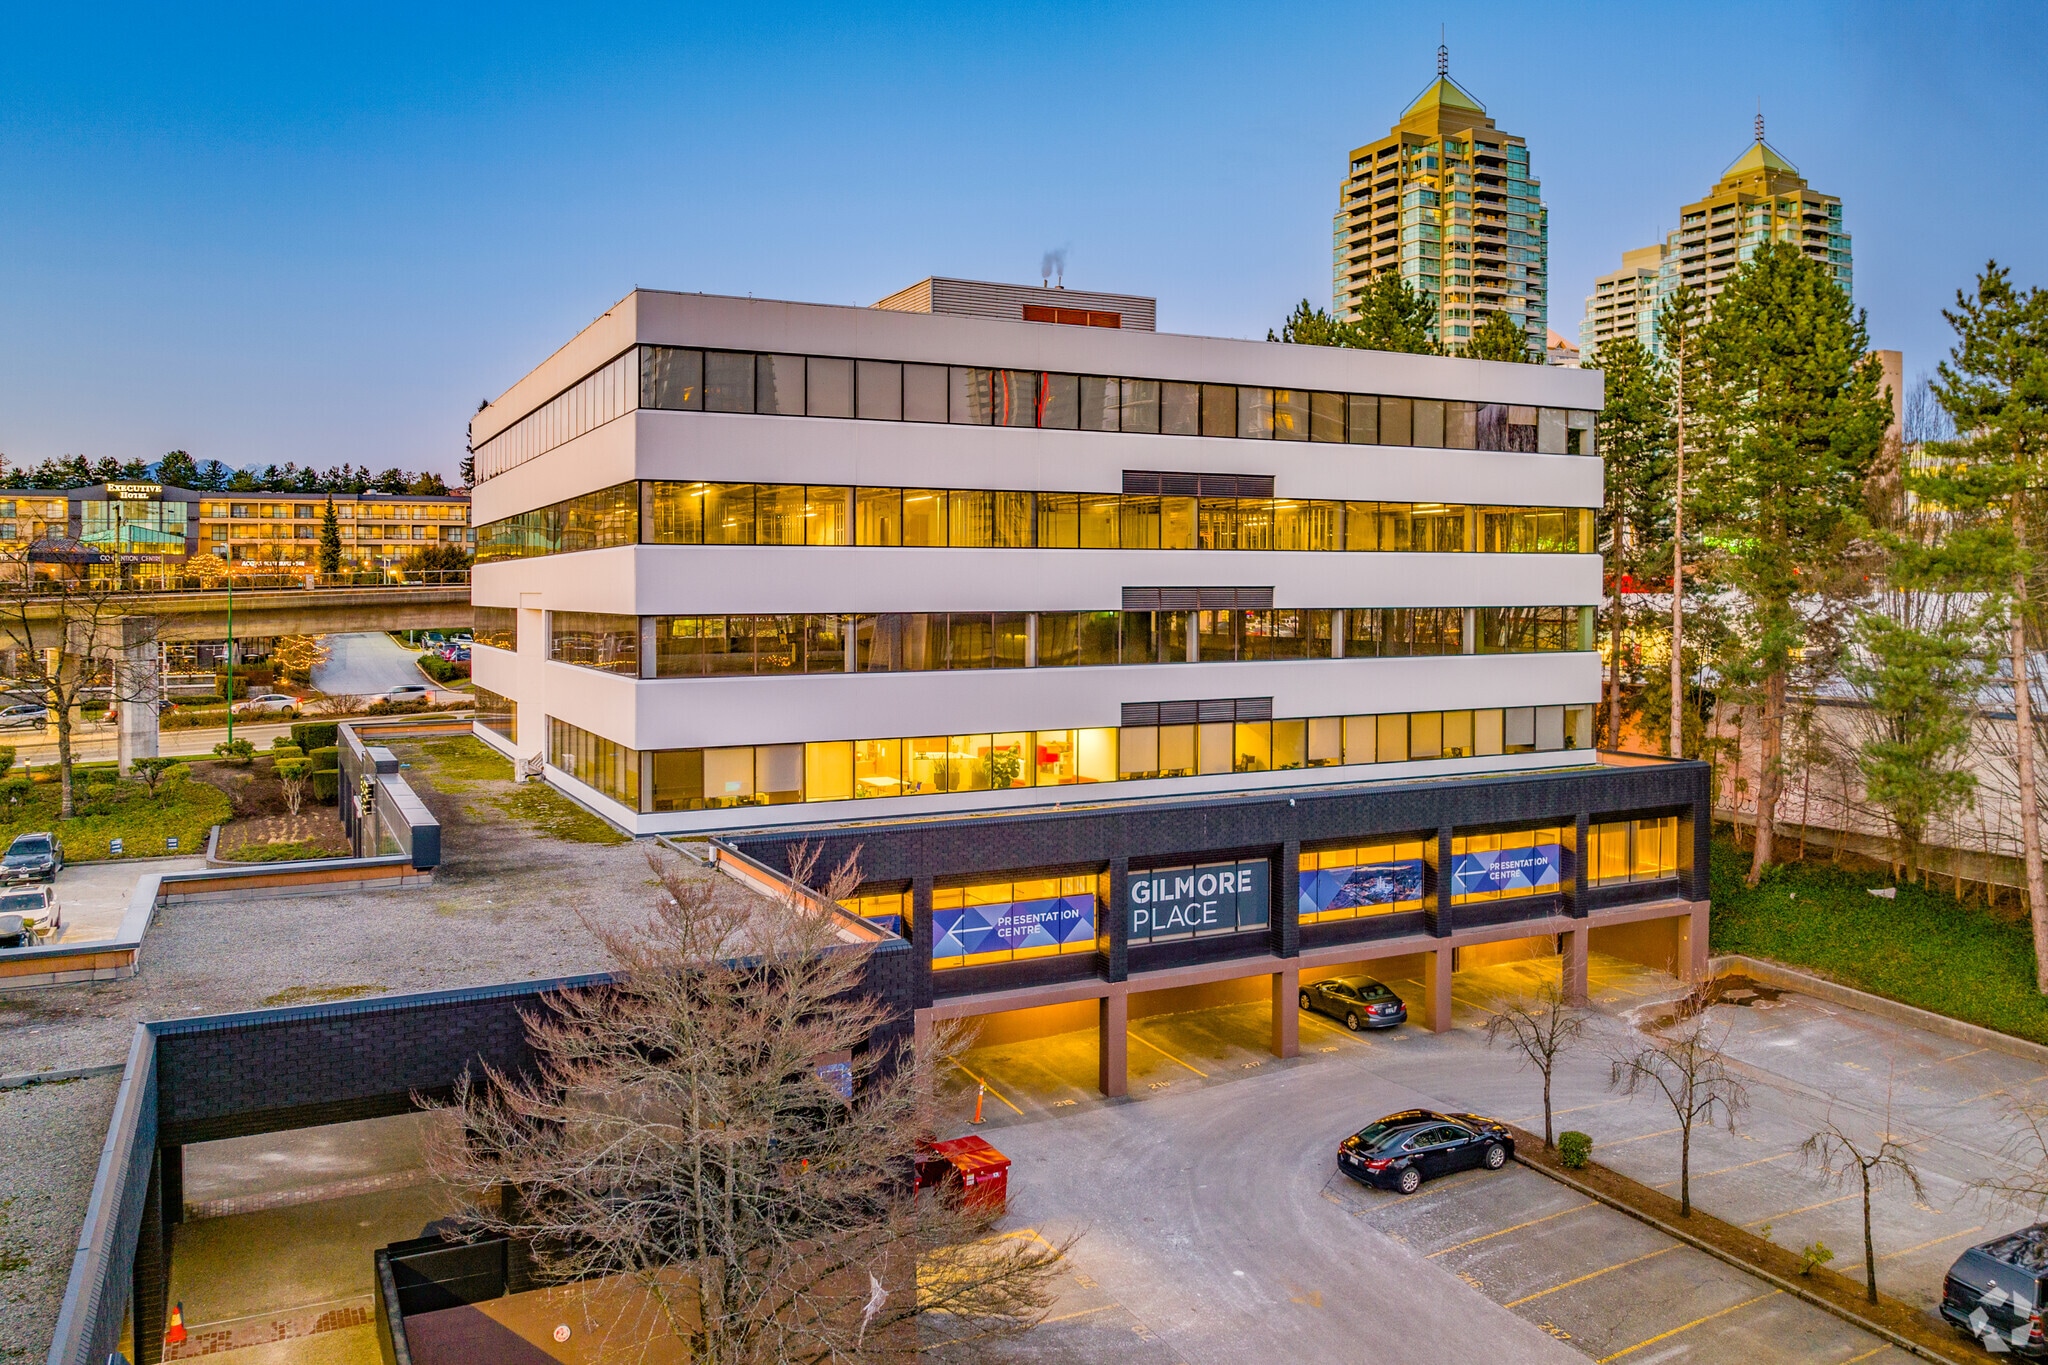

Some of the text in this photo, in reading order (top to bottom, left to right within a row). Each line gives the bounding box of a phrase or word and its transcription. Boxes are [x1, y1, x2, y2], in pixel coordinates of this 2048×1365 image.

[107, 483, 162, 493] EXECUTIVE
[120, 491, 149, 499] HOTEL
[100, 554, 139, 562] CONNTION
[1489, 856, 1548, 871] PRESENTATION
[1489, 869, 1521, 880] CENTRE
[1131, 869, 1252, 904] GILMORE
[997, 908, 1080, 927] PRESENTATION
[1133, 900, 1218, 933] PLACE
[997, 924, 1041, 938] CENTRE
